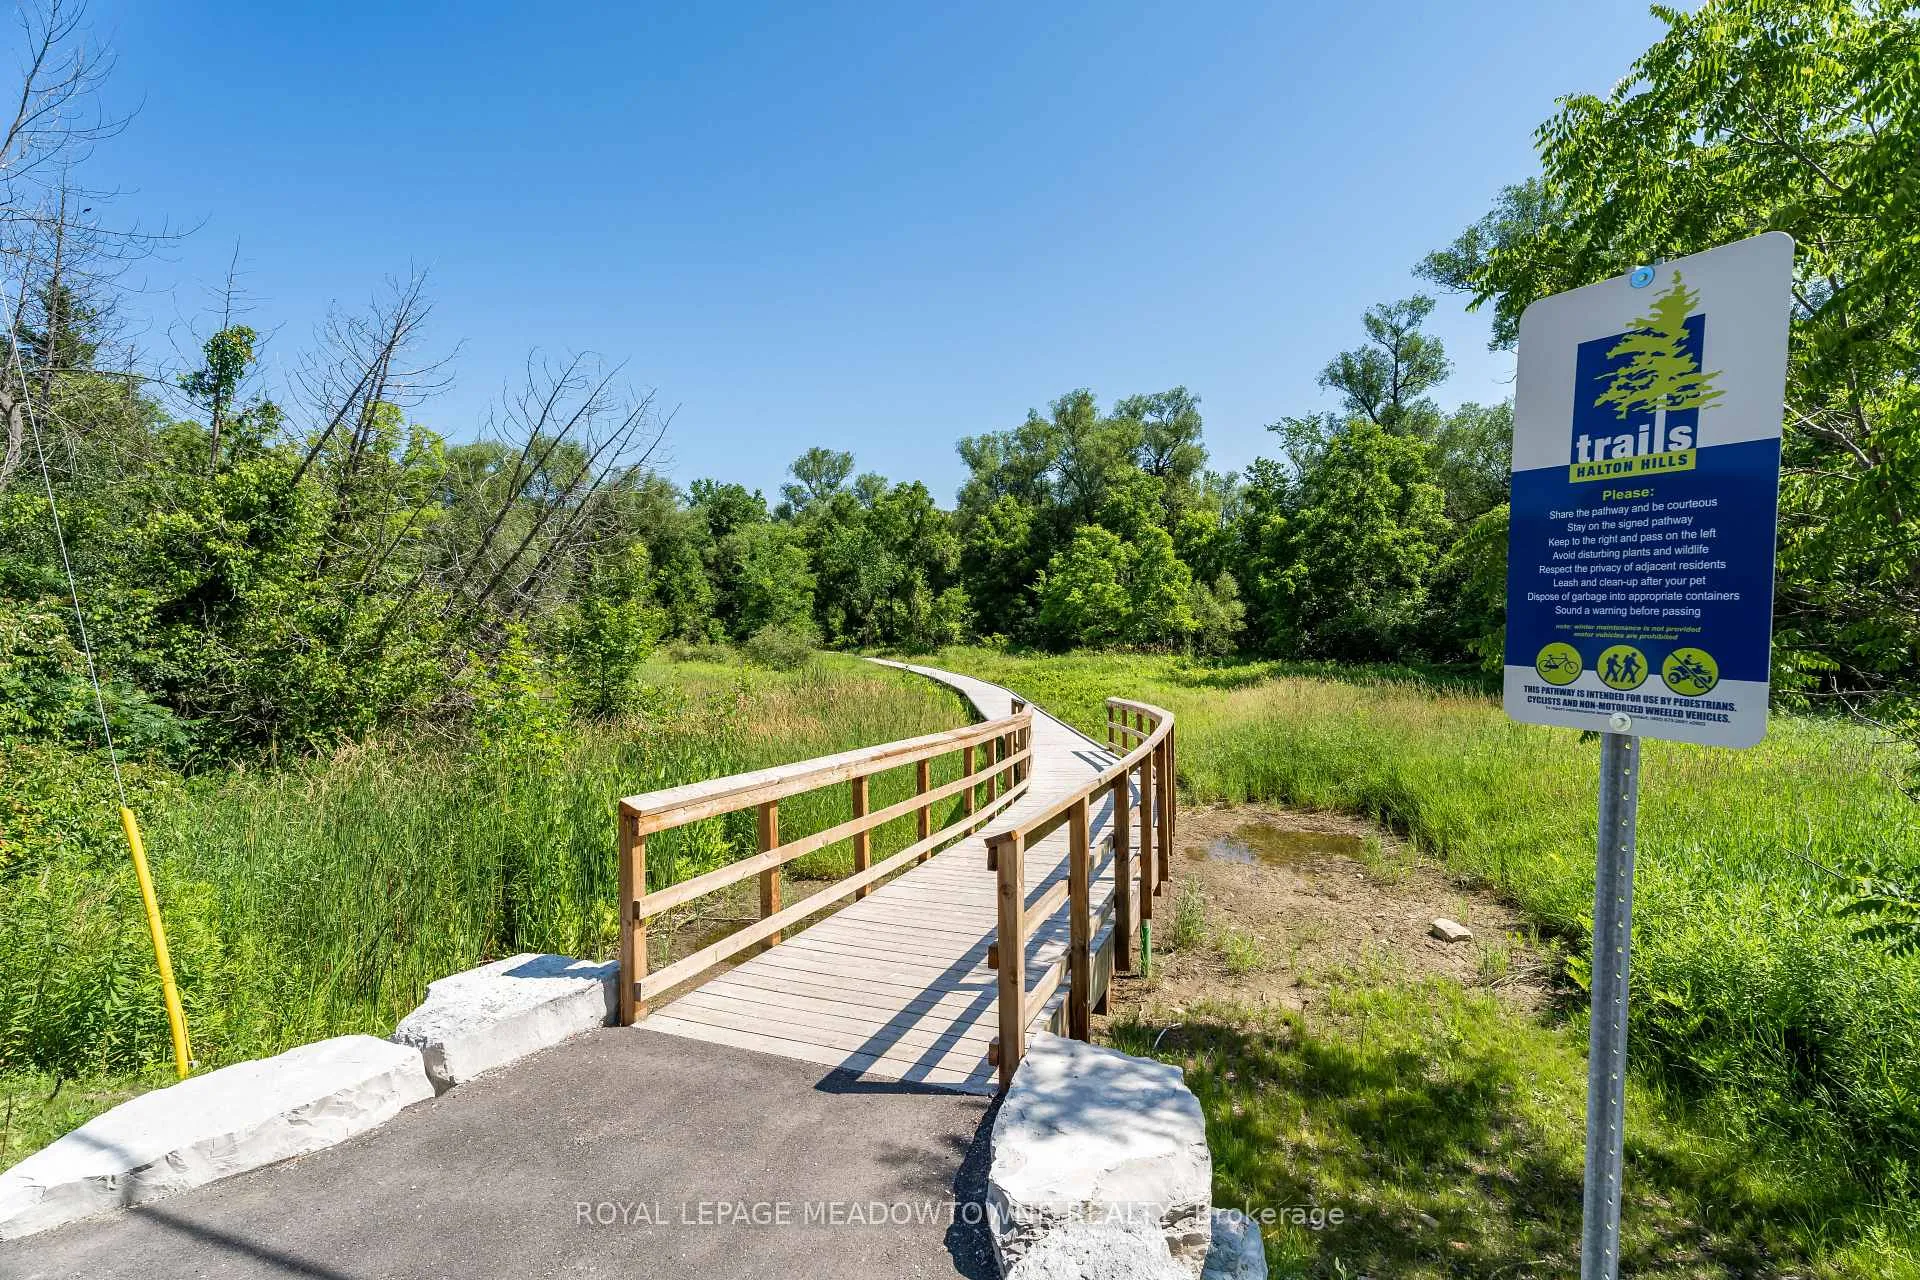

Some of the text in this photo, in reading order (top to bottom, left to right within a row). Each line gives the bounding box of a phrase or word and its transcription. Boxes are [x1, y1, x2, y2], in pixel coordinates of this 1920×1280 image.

[1576, 400, 1692, 464] trails
[1577, 453, 1688, 478] HALTON HILLS
[1603, 488, 1655, 501] Please:
[1549, 499, 1718, 519] Share the pathway and be courteous
[1567, 523, 1586, 533] Stay
[1602, 521, 1615, 529] the
[1618, 518, 1649, 530] signed
[1651, 516, 1693, 528] pathway
[1549, 538, 1570, 547] Keep
[1582, 536, 1596, 544] the
[1598, 535, 1617, 545] right
[1620, 533, 1638, 542] and
[1640, 533, 1663, 543] pass
[1665, 532, 1678, 540] on
[1681, 530, 1697, 539] the
[1700, 528, 1717, 538] left
[1553, 544, 1709, 560] Avoid disturbing plants and wildlife
[1539, 560, 1727, 575] Respect the privacy of adjacent residents
[1553, 576, 1706, 588] Leash and clean-up after your pet
[1527, 591, 1740, 602] Dispose of garbage into appropriate containers
[1555, 605, 1582, 615] Sound
[1592, 607, 1627, 617] warning
[1629, 606, 1660, 615] before
[1662, 607, 1701, 618] passing
[1524, 685, 1540, 693] THIS
[1541, 687, 1575, 697] PATHWAY
[1577, 689, 1584, 698] IS
[1586, 689, 1624, 700] INTENDED
[1626, 694, 1641, 702] FOR
[1643, 695, 1658, 704] USE
[1660, 697, 1672, 705] BY
[1527, 696, 1561, 706] CYCLISTS
[1562, 699, 1578, 707] AND
[1579, 700, 1643, 713] NON-MOTORIZED
[1645, 706, 1683, 718] WHEELED
[1686, 710, 1731, 723] VEHICLES.
